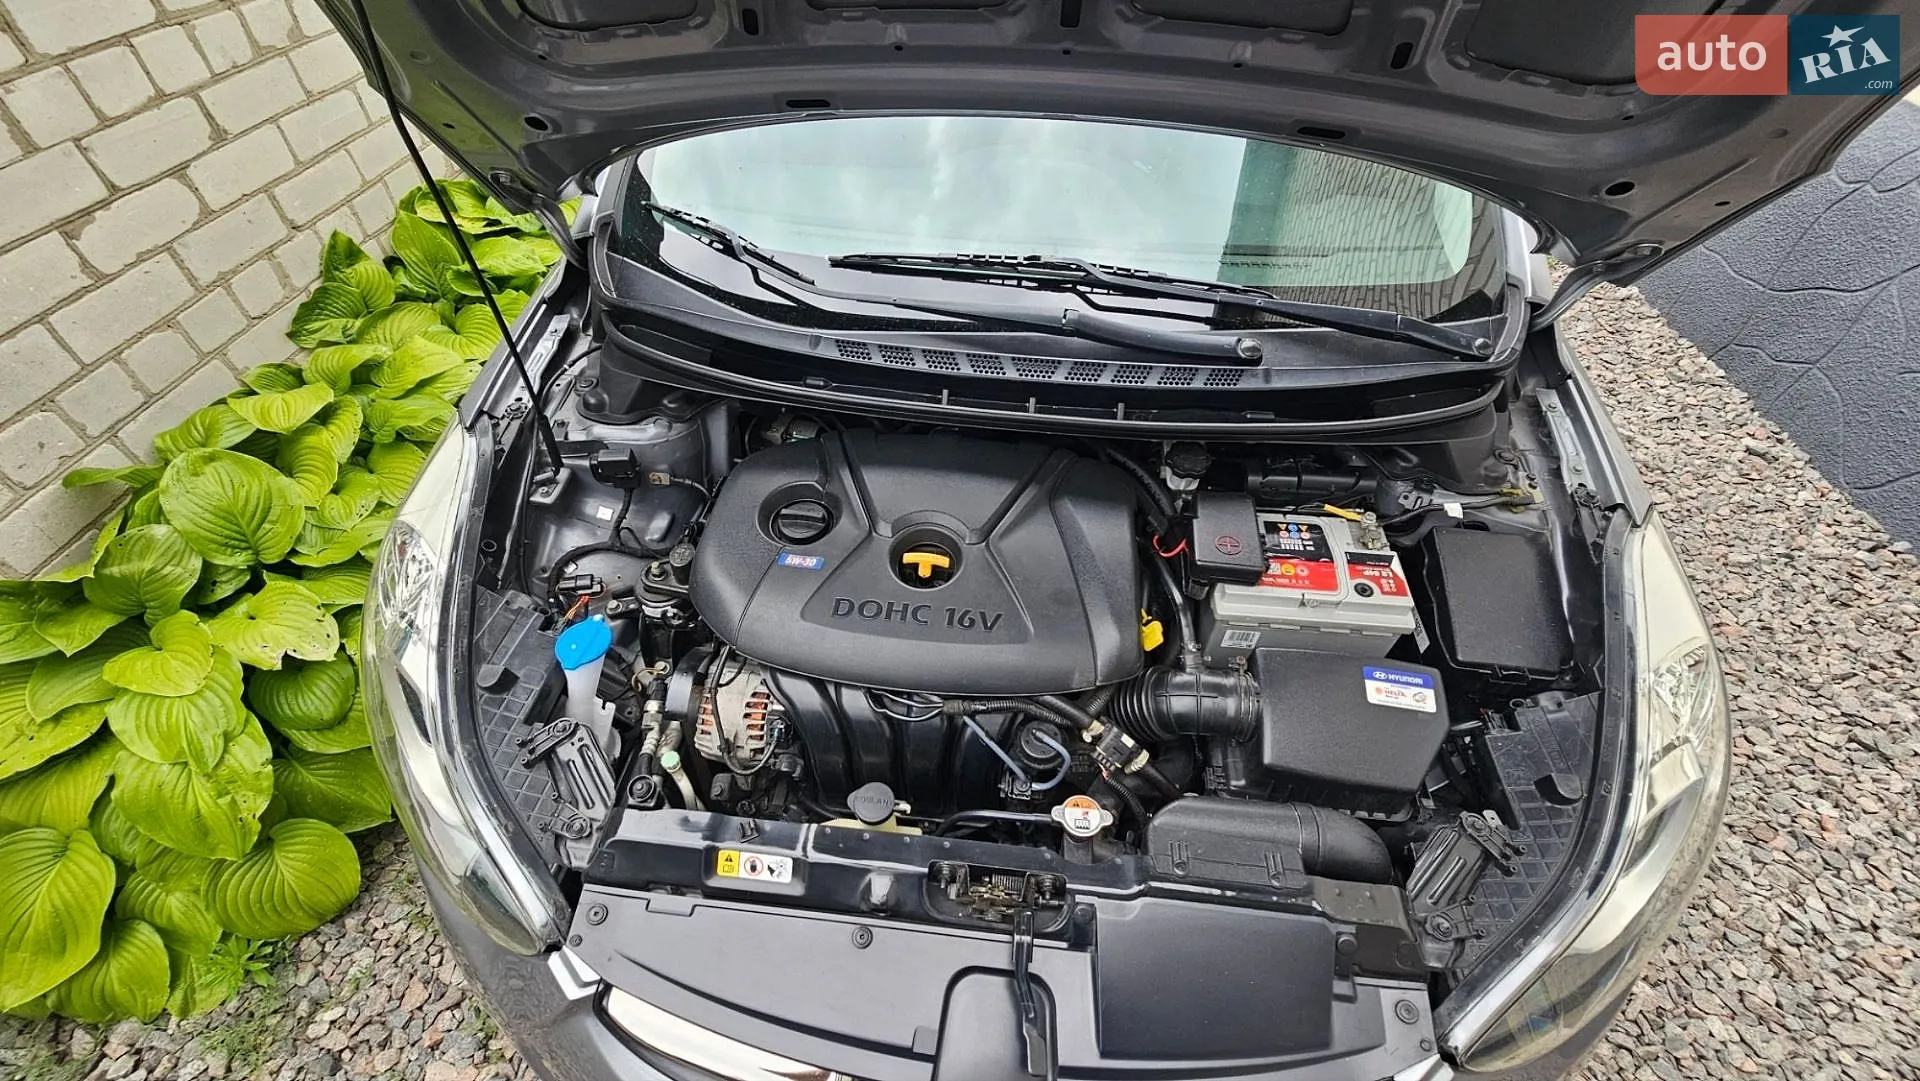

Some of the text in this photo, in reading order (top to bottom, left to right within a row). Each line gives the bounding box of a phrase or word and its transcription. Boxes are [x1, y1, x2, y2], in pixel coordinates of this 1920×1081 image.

[786, 554, 817, 568] 5W-30
[831, 597, 1004, 633] DOHC 16V
[1388, 673, 1424, 685] HYUNDAI
